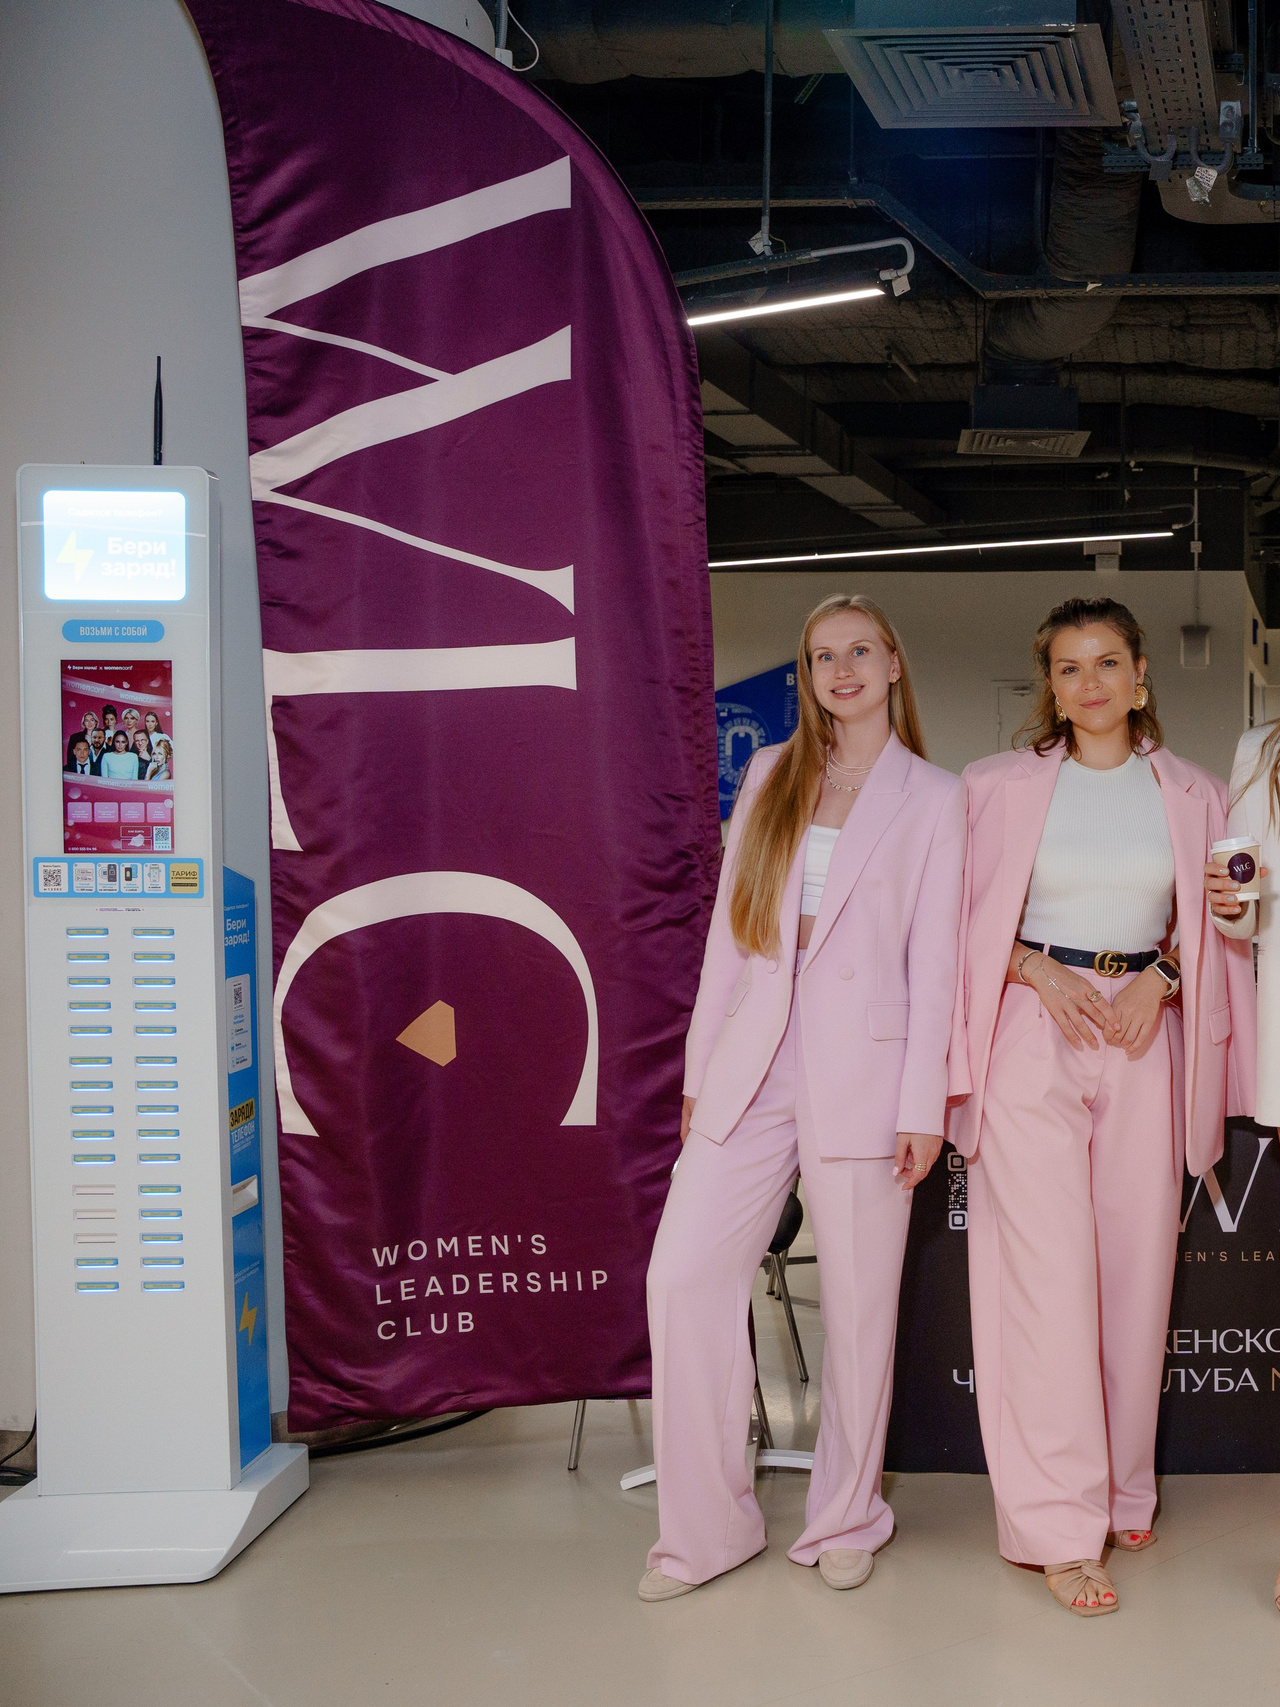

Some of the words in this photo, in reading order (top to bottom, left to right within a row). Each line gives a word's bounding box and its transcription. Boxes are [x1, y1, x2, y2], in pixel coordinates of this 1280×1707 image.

[107, 537, 167, 558] Бери
[101, 559, 177, 580] заряд!
[80, 627, 112, 636] ВОЗЬМИ
[114, 627, 120, 636] С
[121, 625, 147, 636] СОБОЙ
[239, 154, 598, 1137] WLC
[1233, 862, 1251, 873] WLC
[226, 918, 247, 932] Бери
[224, 930, 250, 947] заряд!
[230, 1100, 254, 1127] ЗАРЯДИ
[231, 1120, 255, 1144] ТЕЛЕФОН
[372, 1234, 547, 1267] WOMEN'S
[1176, 1251, 1228, 1262] EN'S
[375, 1270, 608, 1305] LEADERSHIP
[377, 1312, 475, 1340] CLUB
